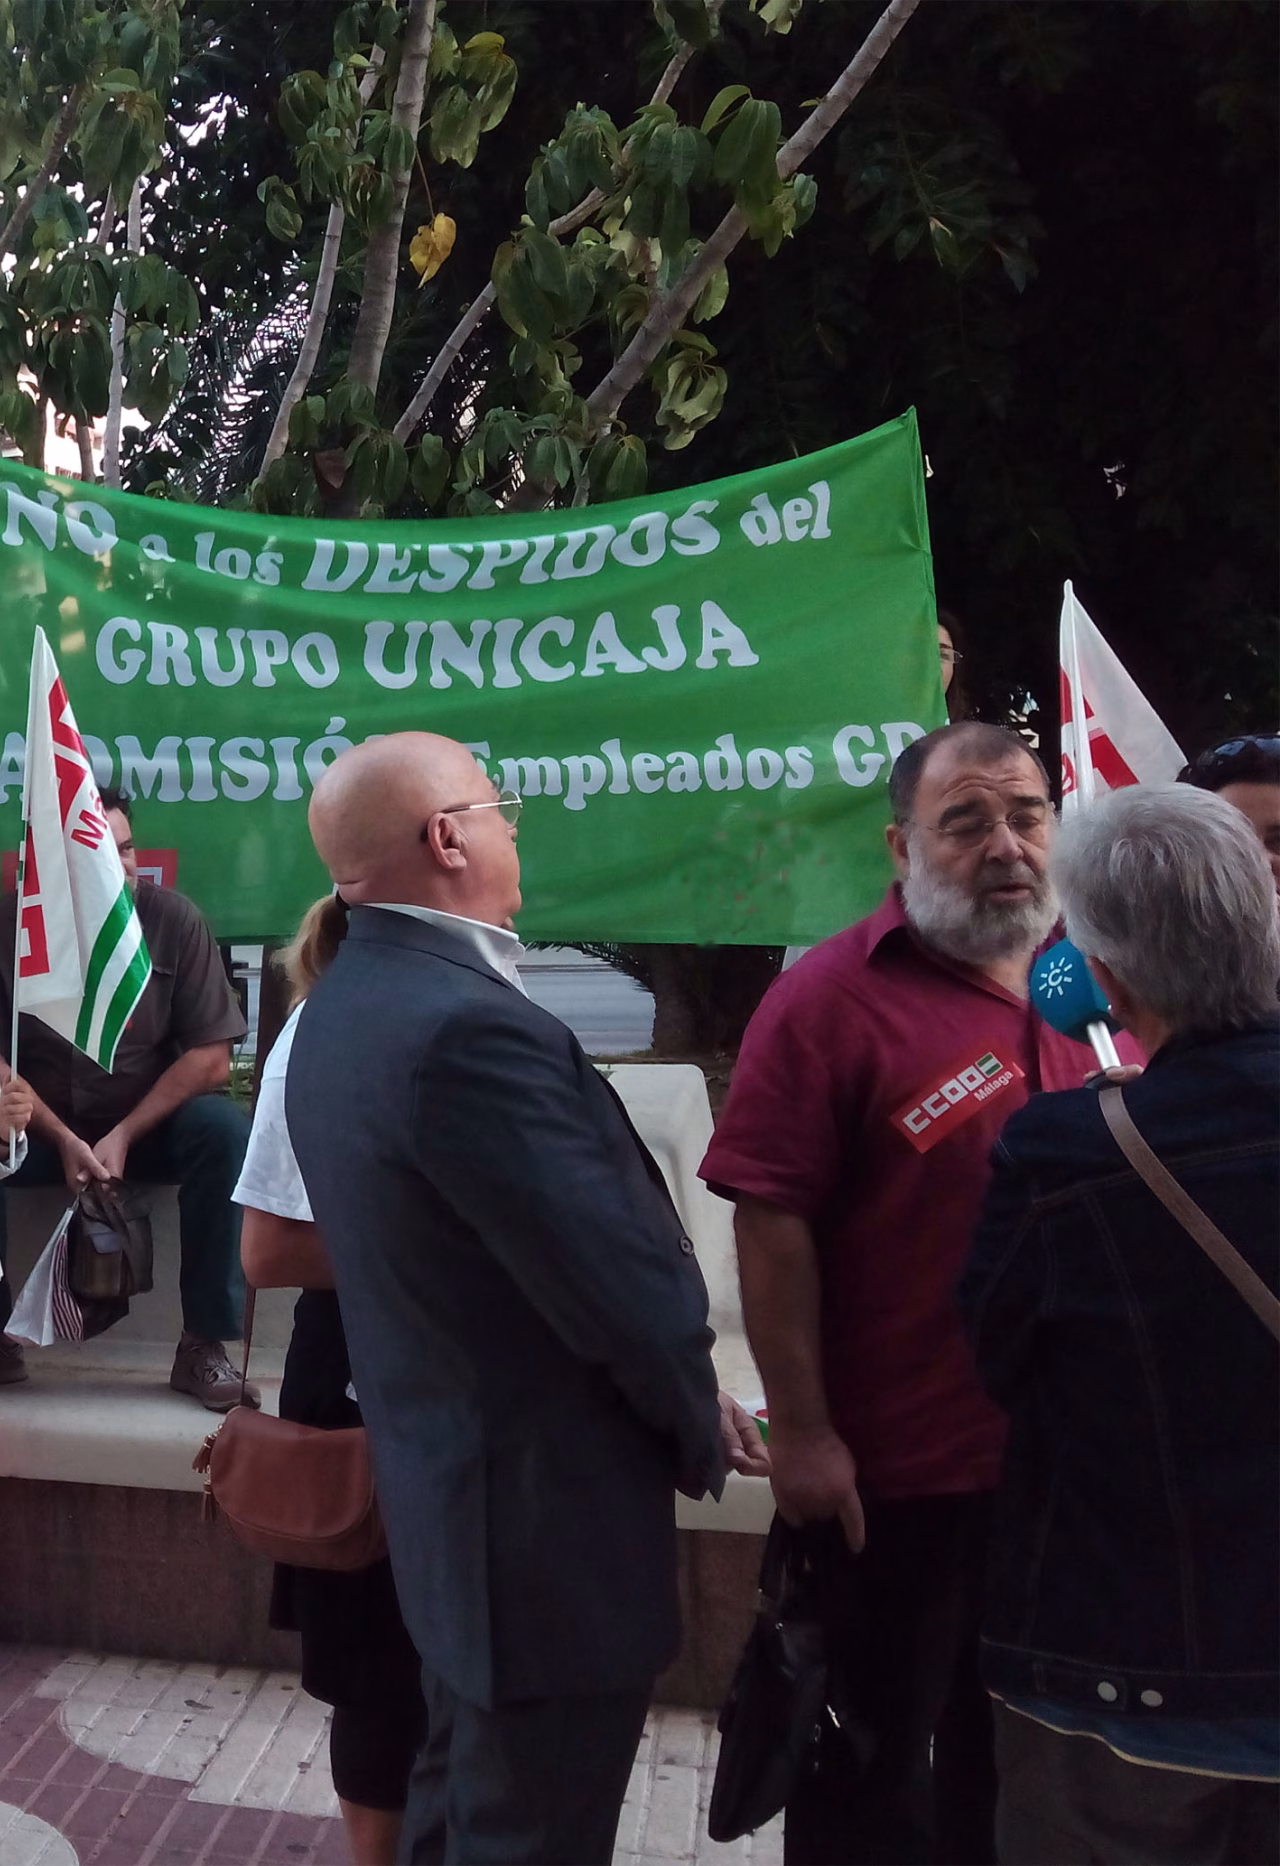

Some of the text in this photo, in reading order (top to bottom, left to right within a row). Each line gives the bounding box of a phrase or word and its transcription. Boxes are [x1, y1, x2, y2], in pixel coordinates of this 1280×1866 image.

[139, 533, 176, 563] a
[194, 531, 284, 586] los
[301, 499, 721, 594] DESPIDOS
[740, 480, 832, 548] del
[95, 600, 760, 690] GRUPO UNICAJA
[903, 1065, 986, 1134] CCOO
[974, 1070, 1013, 1101] Málaga
